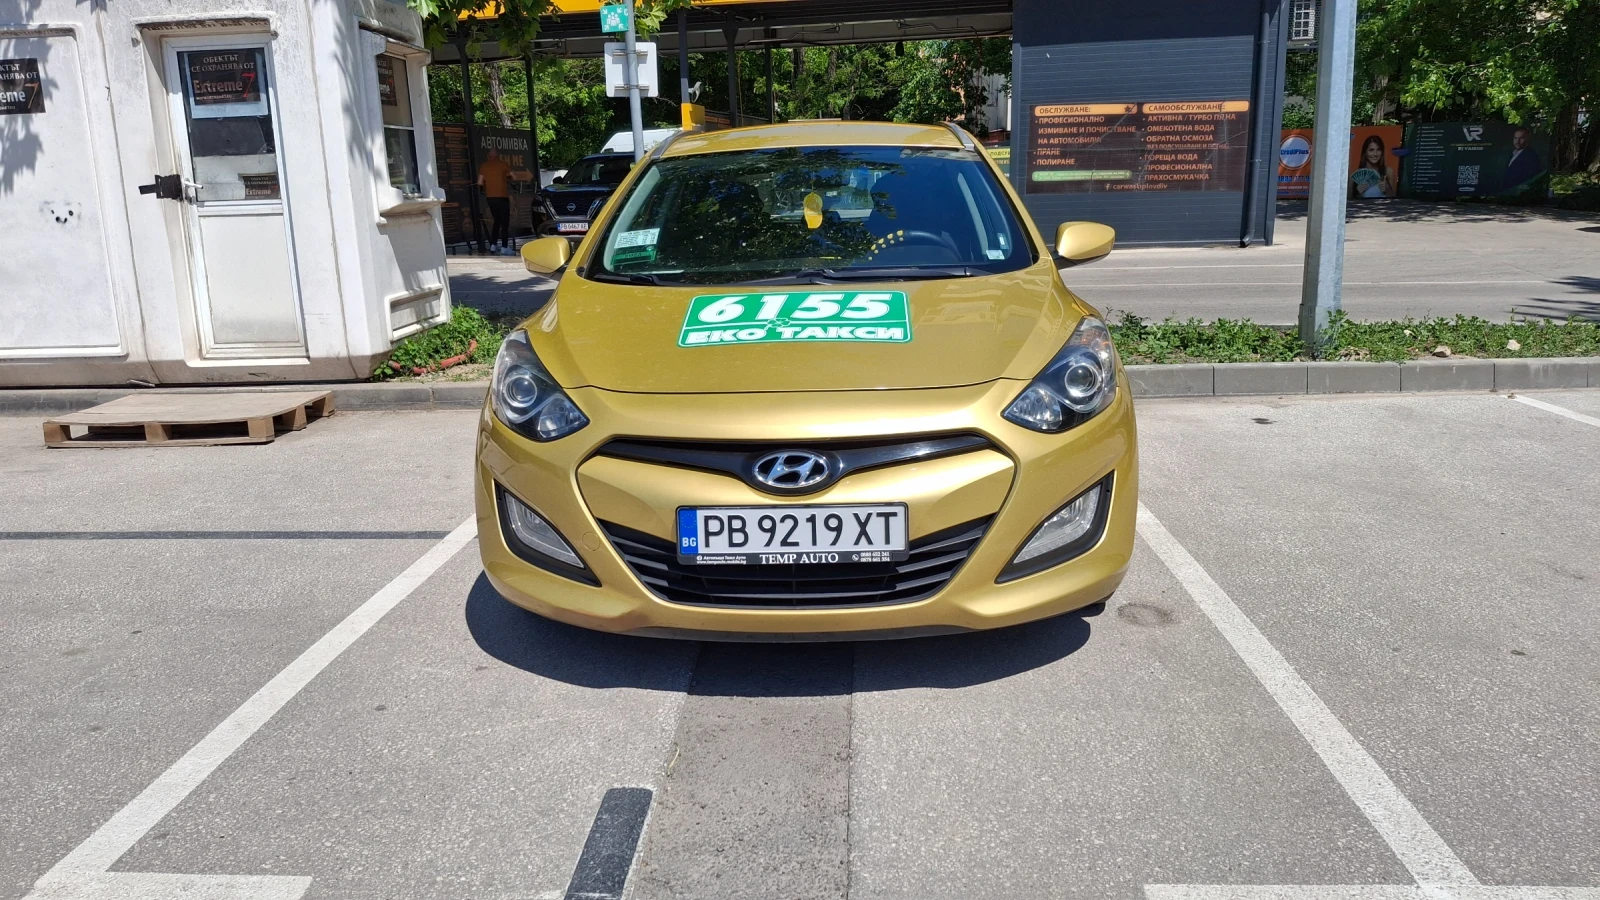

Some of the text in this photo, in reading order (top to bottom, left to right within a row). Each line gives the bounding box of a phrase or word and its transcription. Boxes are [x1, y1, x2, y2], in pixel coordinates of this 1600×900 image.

[203, 54, 239, 64] ОБЕКТЪТ
[191, 65, 201, 73] СЕ
[202, 64, 243, 72] ОХРАНЯВА
[193, 80, 243, 94] Extreme
[1038, 116, 1105, 124] ПРОФЕСИОНАЛНО
[1038, 127, 1078, 135] ИЗМИВАНЕ
[1194, 124, 1215, 132] ВОДА
[481, 136, 528, 151] АВТОМИВКА
[1177, 153, 1198, 161] ВОДА
[1036, 158, 1076, 166] ПОЛИРАНЕ
[1145, 163, 1213, 171] ПРОФЕСИОНАЛНА
[1144, 173, 1210, 181] ПРАХОСМУКАЧКА
[697, 293, 893, 323] 6155
[685, 326, 904, 345] ЕКО ТАКСИ
[682, 511, 898, 548] BG PB 9219 XT
[759, 552, 839, 565] TEMP AUTO
